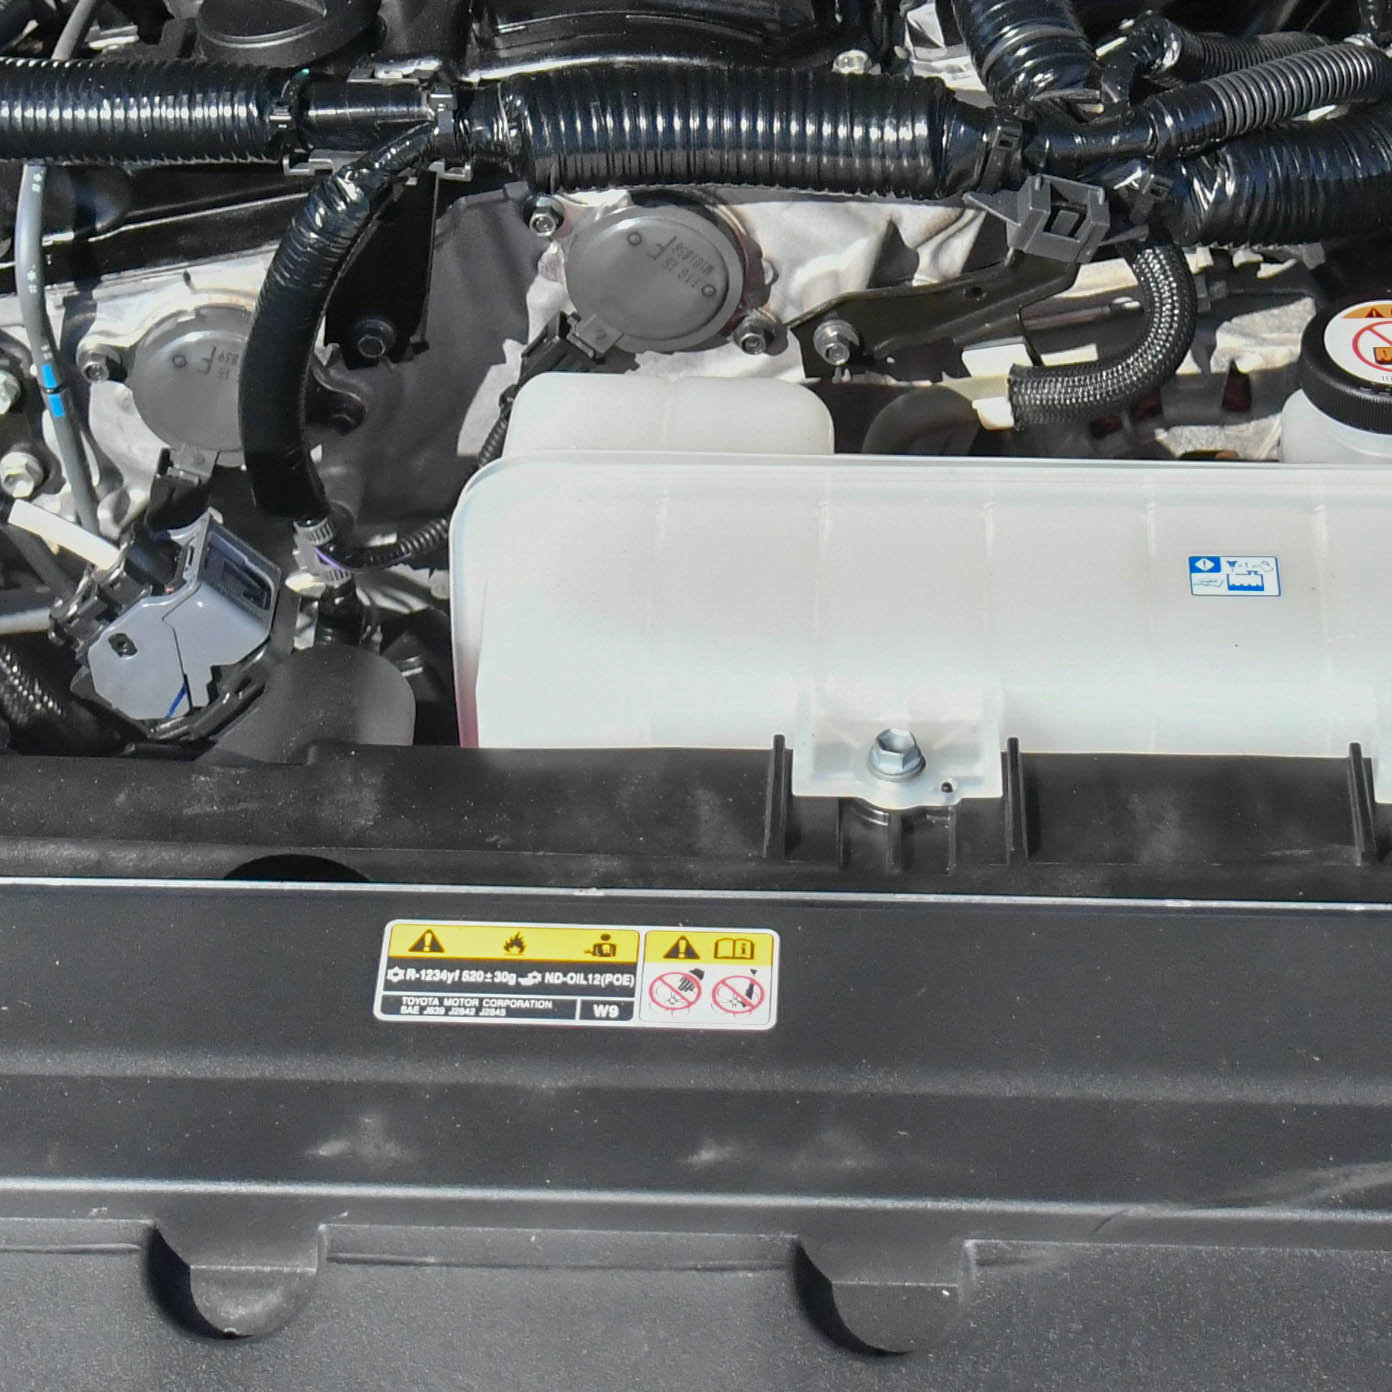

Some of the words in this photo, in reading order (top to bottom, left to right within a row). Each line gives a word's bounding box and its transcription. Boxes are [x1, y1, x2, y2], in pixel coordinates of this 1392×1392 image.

[544, 971, 635, 988] ND-OIL12(POE)
[402, 997, 440, 1006] TOYOTA
[443, 998, 479, 1007] MOTOR
[482, 998, 553, 1009] CORPORATION
[593, 1003, 620, 1018] W9
